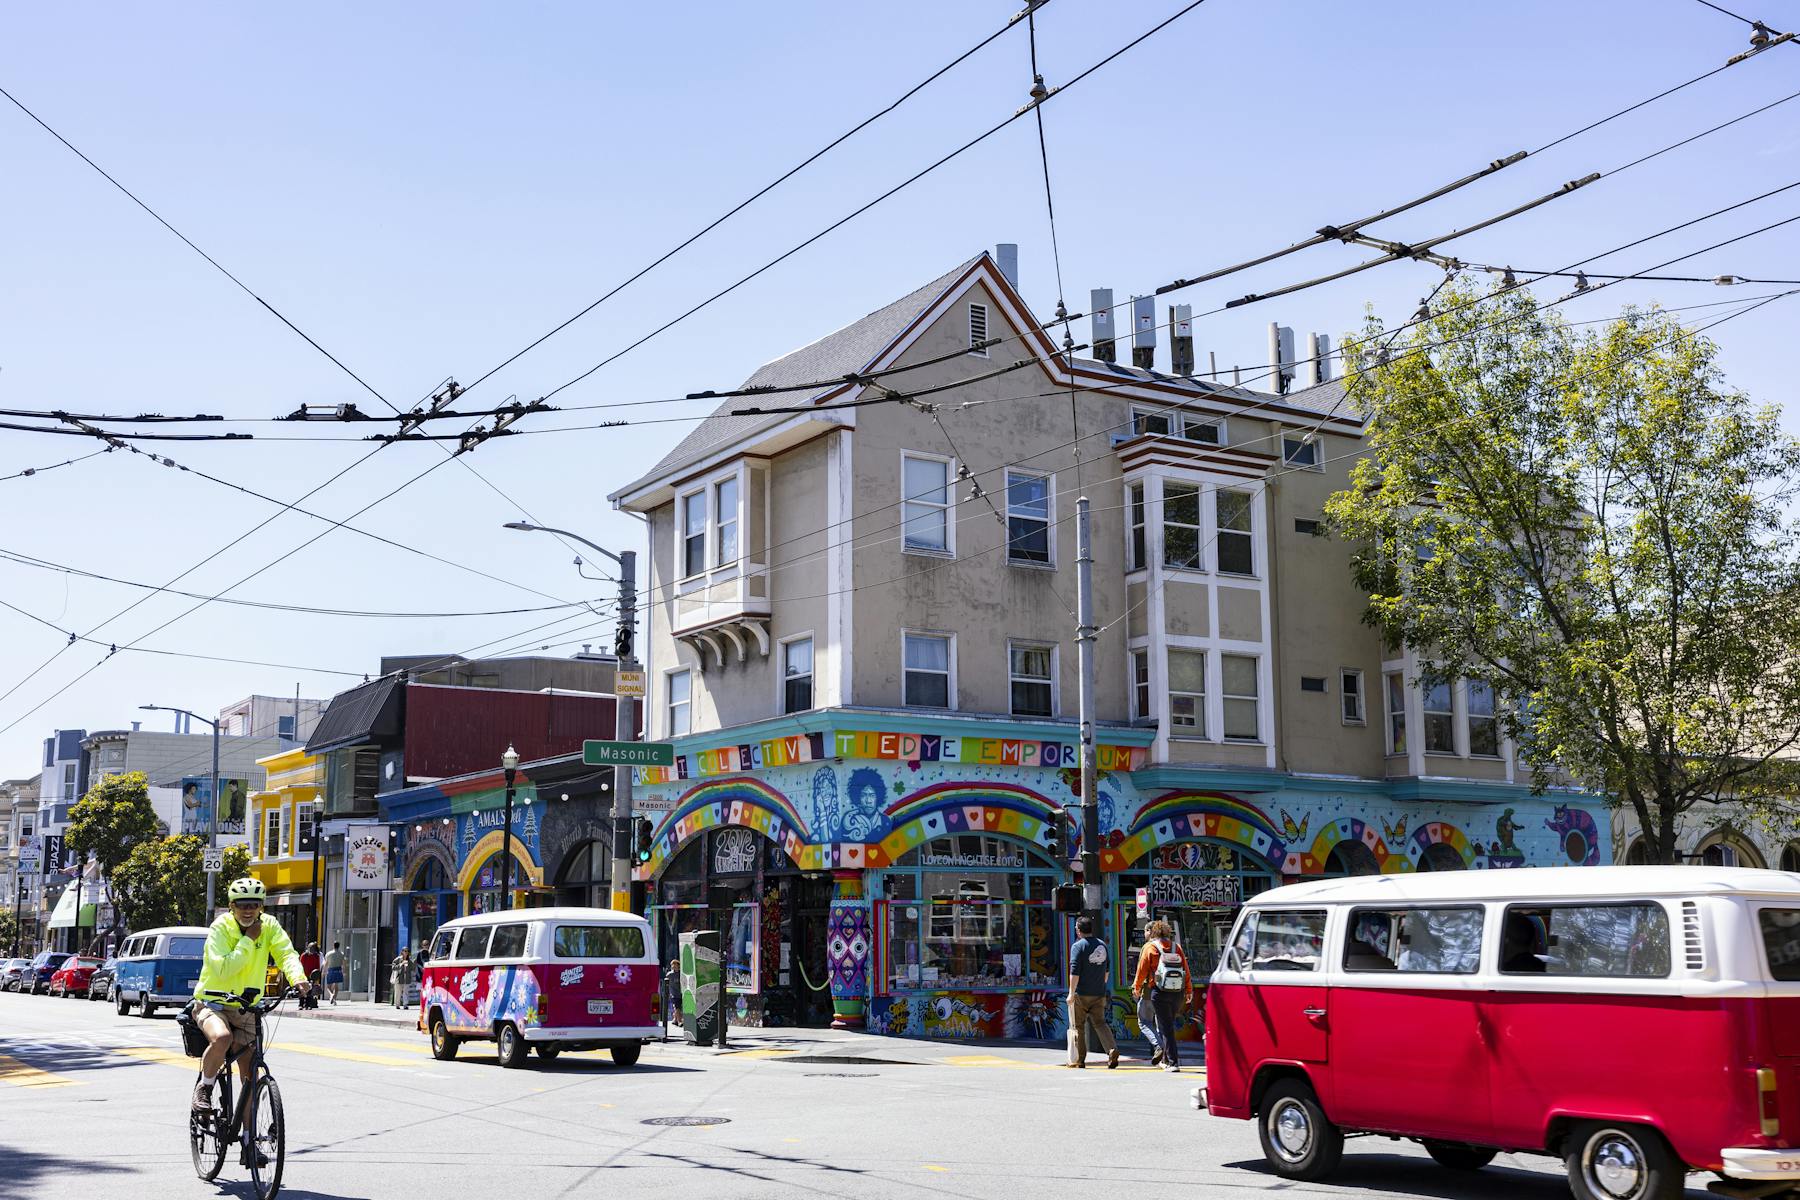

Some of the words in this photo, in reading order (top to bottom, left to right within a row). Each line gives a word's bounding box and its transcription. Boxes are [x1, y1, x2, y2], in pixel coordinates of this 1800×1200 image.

[600, 747, 659, 761] Masonic
[633, 758, 686, 783] ARIT
[698, 739, 810, 773] COLECTIV
[981, 741, 1131, 766] EMPORUM
[640, 801, 671, 809] Masonic
[478, 809, 506, 827] AMAL'S
[182, 821, 246, 834] PLAYOUSE
[50, 836, 60, 876] SFJAZZ
[205, 860, 221, 869] 20
